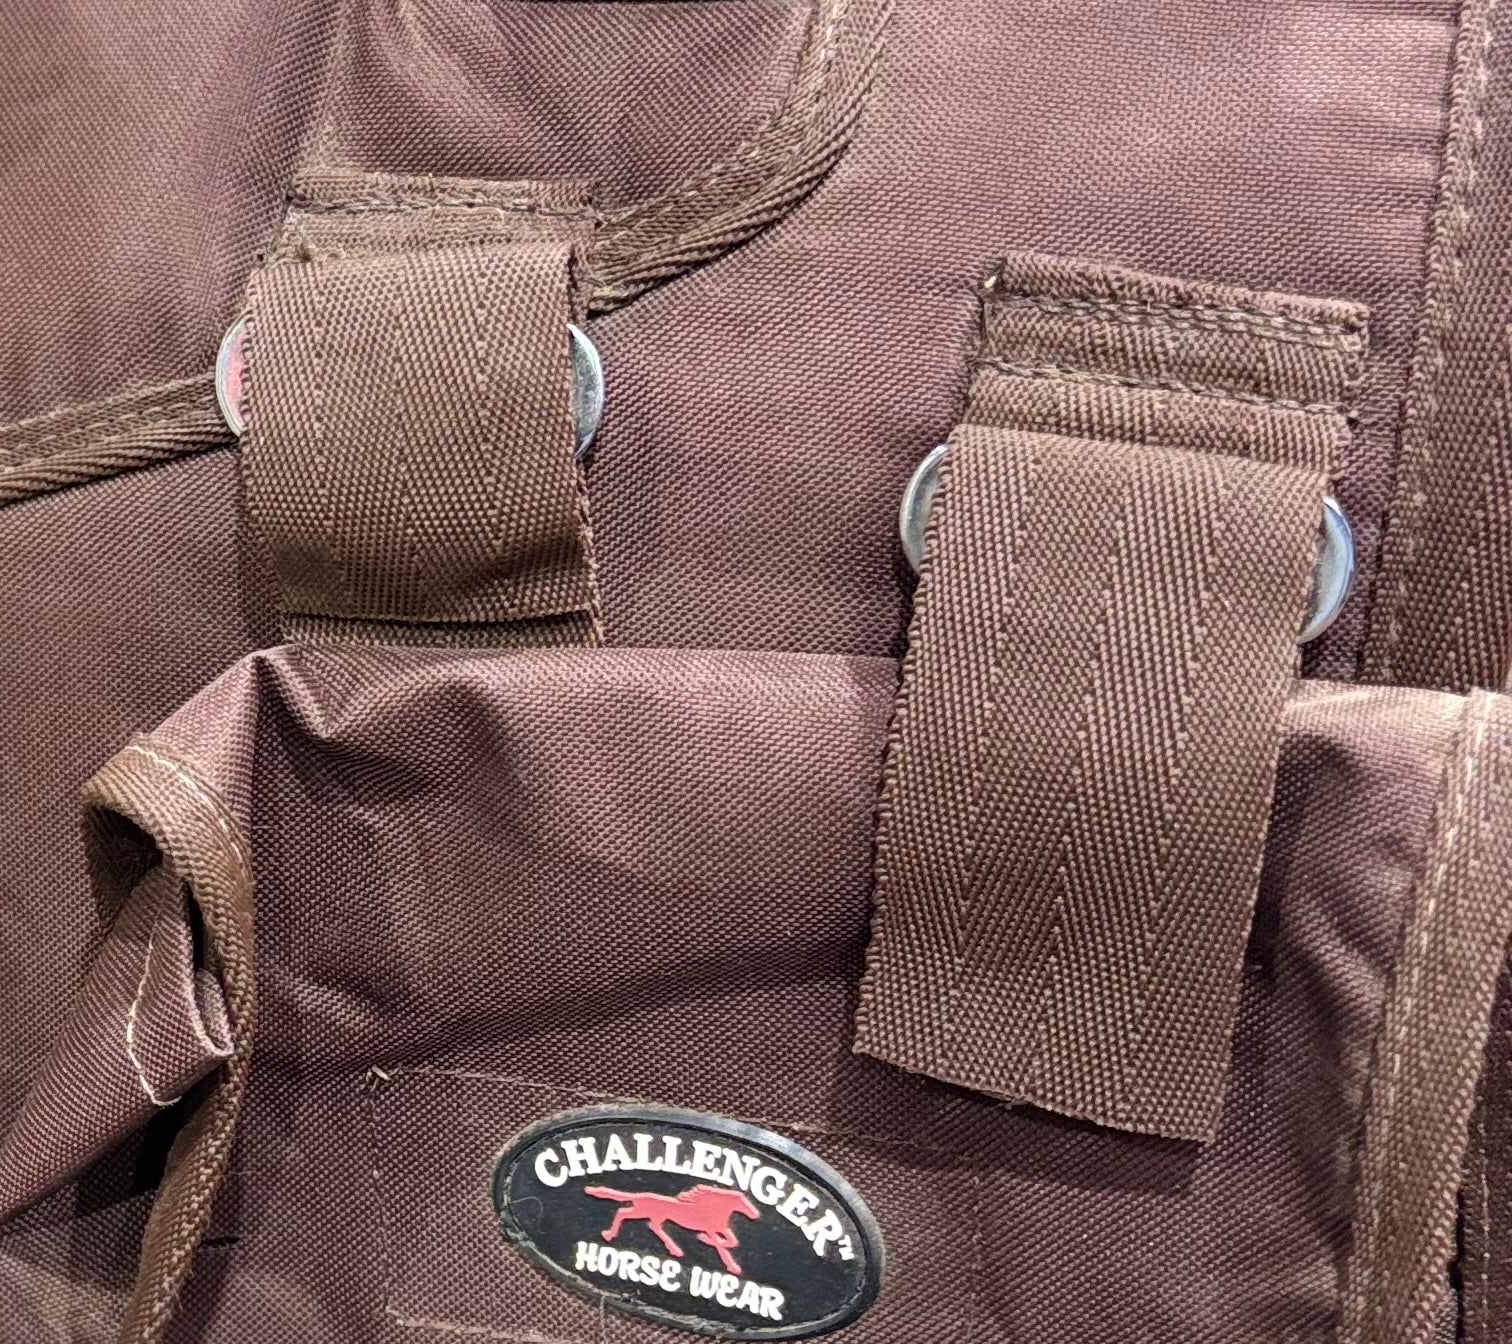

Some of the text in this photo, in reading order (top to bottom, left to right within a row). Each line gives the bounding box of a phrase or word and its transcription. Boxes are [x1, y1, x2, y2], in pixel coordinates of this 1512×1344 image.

[534, 1133, 843, 1256] CHALLENGER
[575, 1240, 785, 1321] HORSE WEAR
